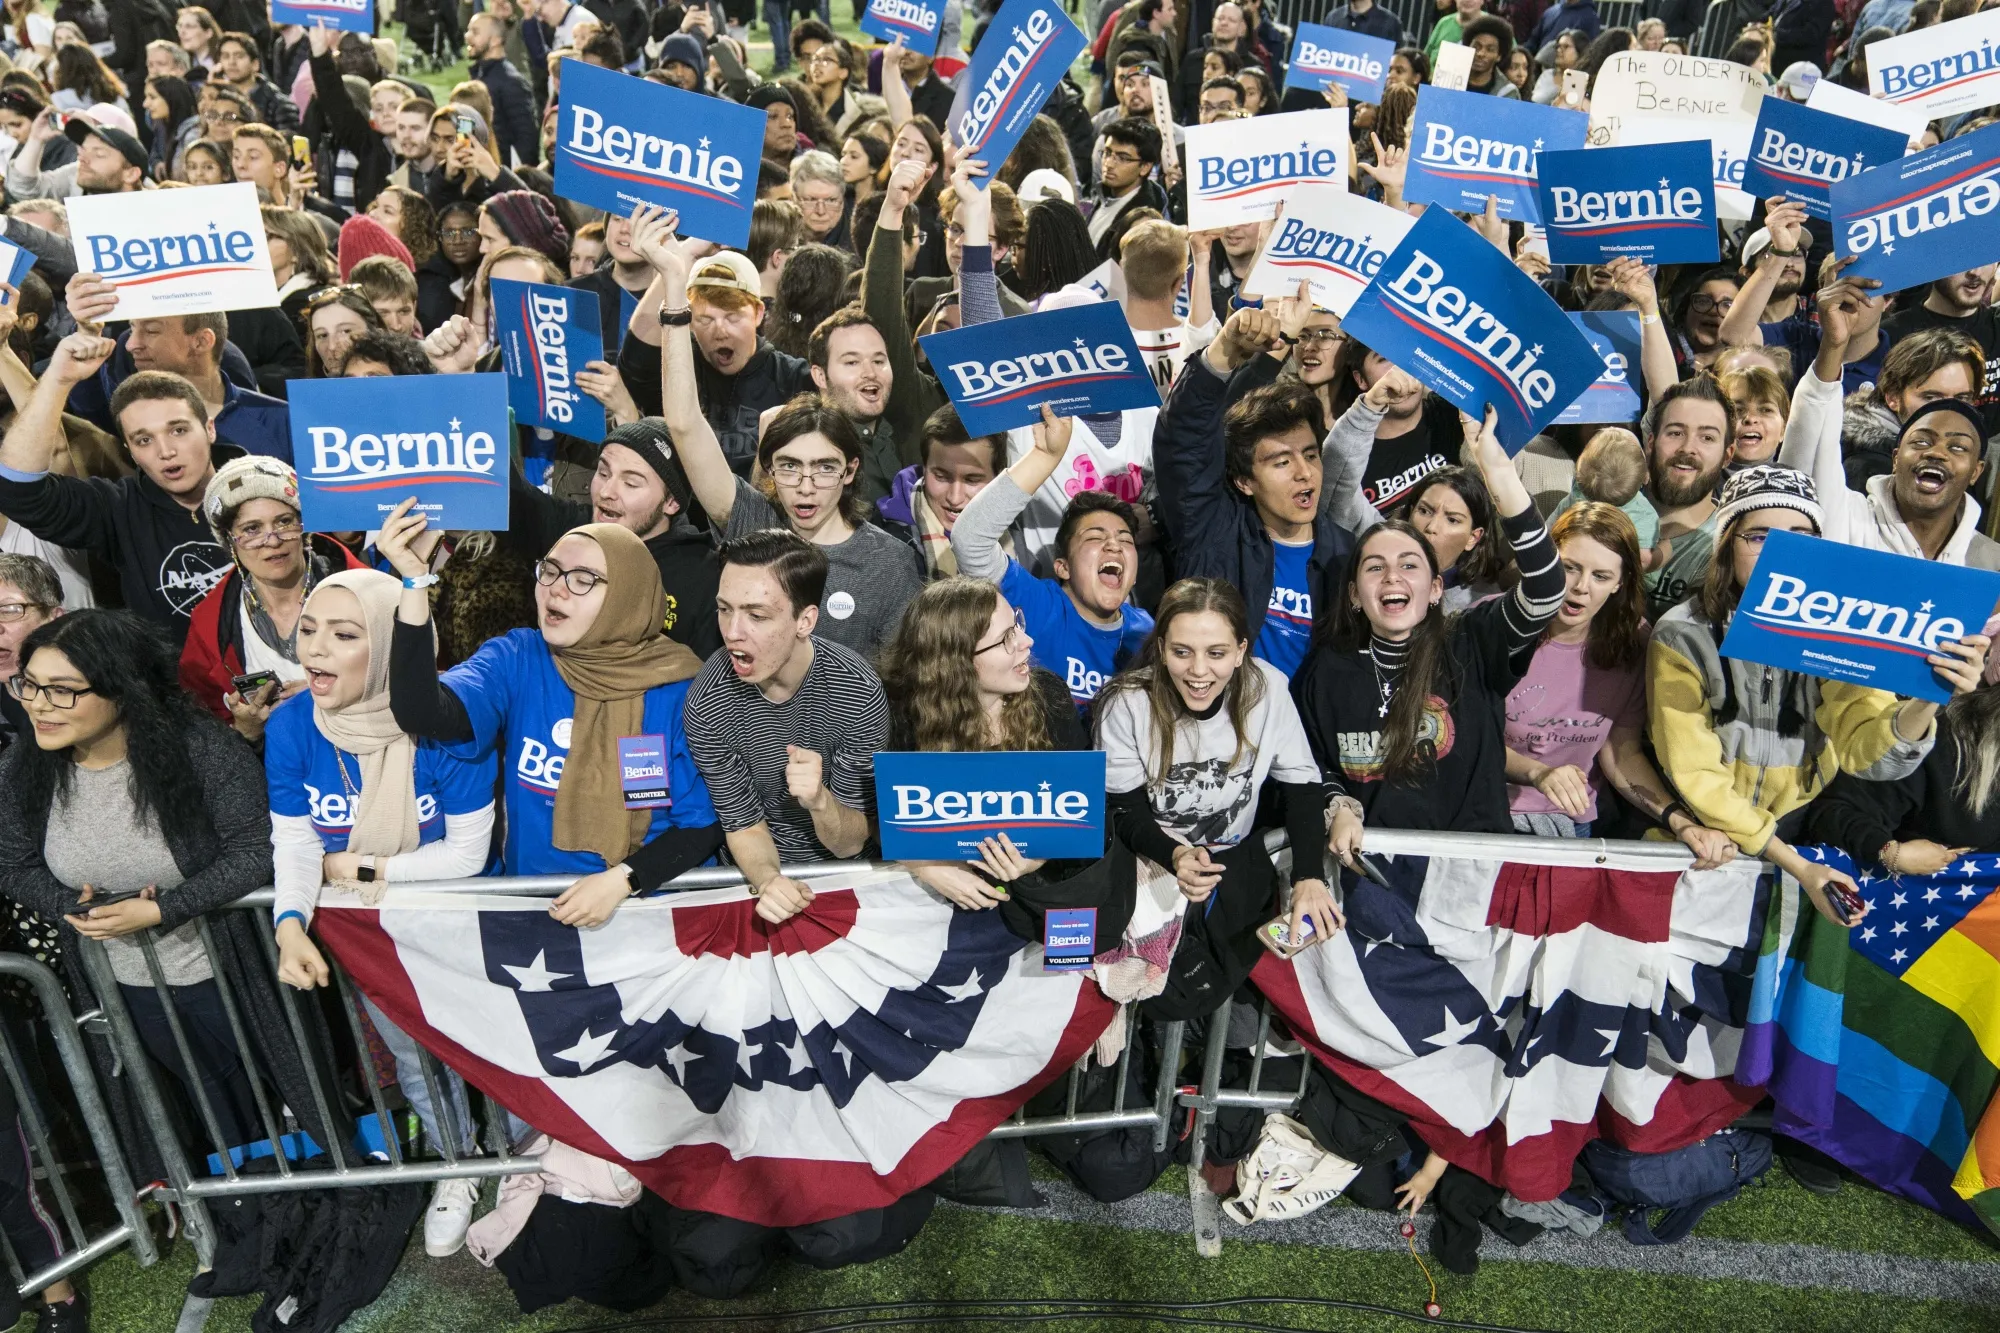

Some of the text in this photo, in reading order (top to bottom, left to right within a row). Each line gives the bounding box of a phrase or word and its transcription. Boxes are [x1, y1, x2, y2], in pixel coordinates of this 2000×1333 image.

[958, 9, 1053, 146] Bernie
[1297, 41, 1383, 80] Bernie
[1615, 57, 1762, 89] The OLDER The
[1879, 38, 2000, 95] Berni
[568, 104, 743, 194] Bernie
[1198, 140, 1337, 190] Bernie
[1421, 122, 1544, 179] Berni
[1758, 127, 1877, 183] Berni
[1550, 176, 1703, 222] Bernie
[1847, 179, 2000, 257] ernie
[86, 220, 255, 273] Bernie
[1272, 218, 1388, 278] Bernie
[1387, 249, 1556, 408] Bernie
[533, 293, 580, 423] Bernie
[948, 337, 1129, 397] Bernie
[1414, 347, 1475, 392] BernieSanders.com
[307, 416, 496, 474] Bernie
[1375, 453, 1447, 499] Bernie
[167, 570, 222, 589] NAS
[1754, 572, 1965, 650] Bernie
[1802, 649, 1876, 671] BernieSanders.com
[1526, 731, 1544, 741] for
[1546, 731, 1599, 743] President
[624, 764, 664, 778] Bernie
[628, 790, 666, 799] VOLUNTEER
[892, 780, 1089, 821] Bernie
[1049, 934, 1091, 946] Bernie
